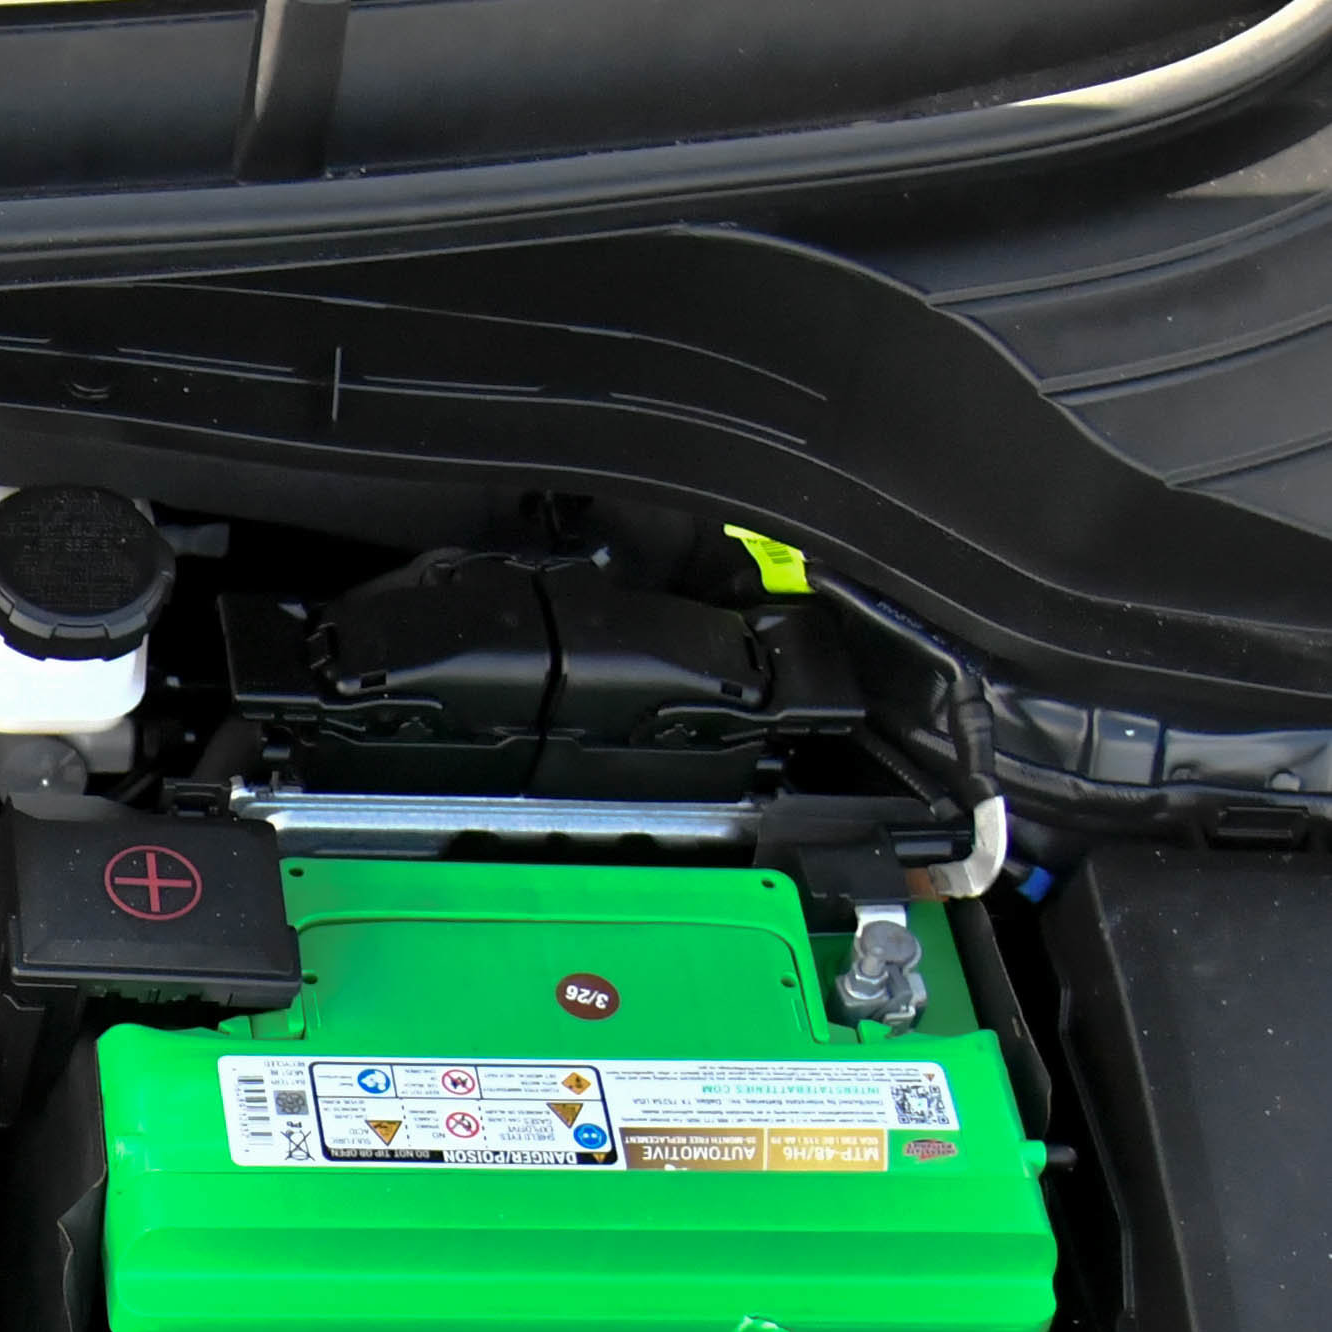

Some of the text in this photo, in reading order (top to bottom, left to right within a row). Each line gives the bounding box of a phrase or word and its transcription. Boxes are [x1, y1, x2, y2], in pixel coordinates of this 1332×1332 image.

[565, 985, 609, 1009] 3/26
[394, 1149, 412, 1157] NOT
[443, 1151, 577, 1164] DANGER/POISON
[642, 1146, 755, 1160] AUTOMOTIVE
